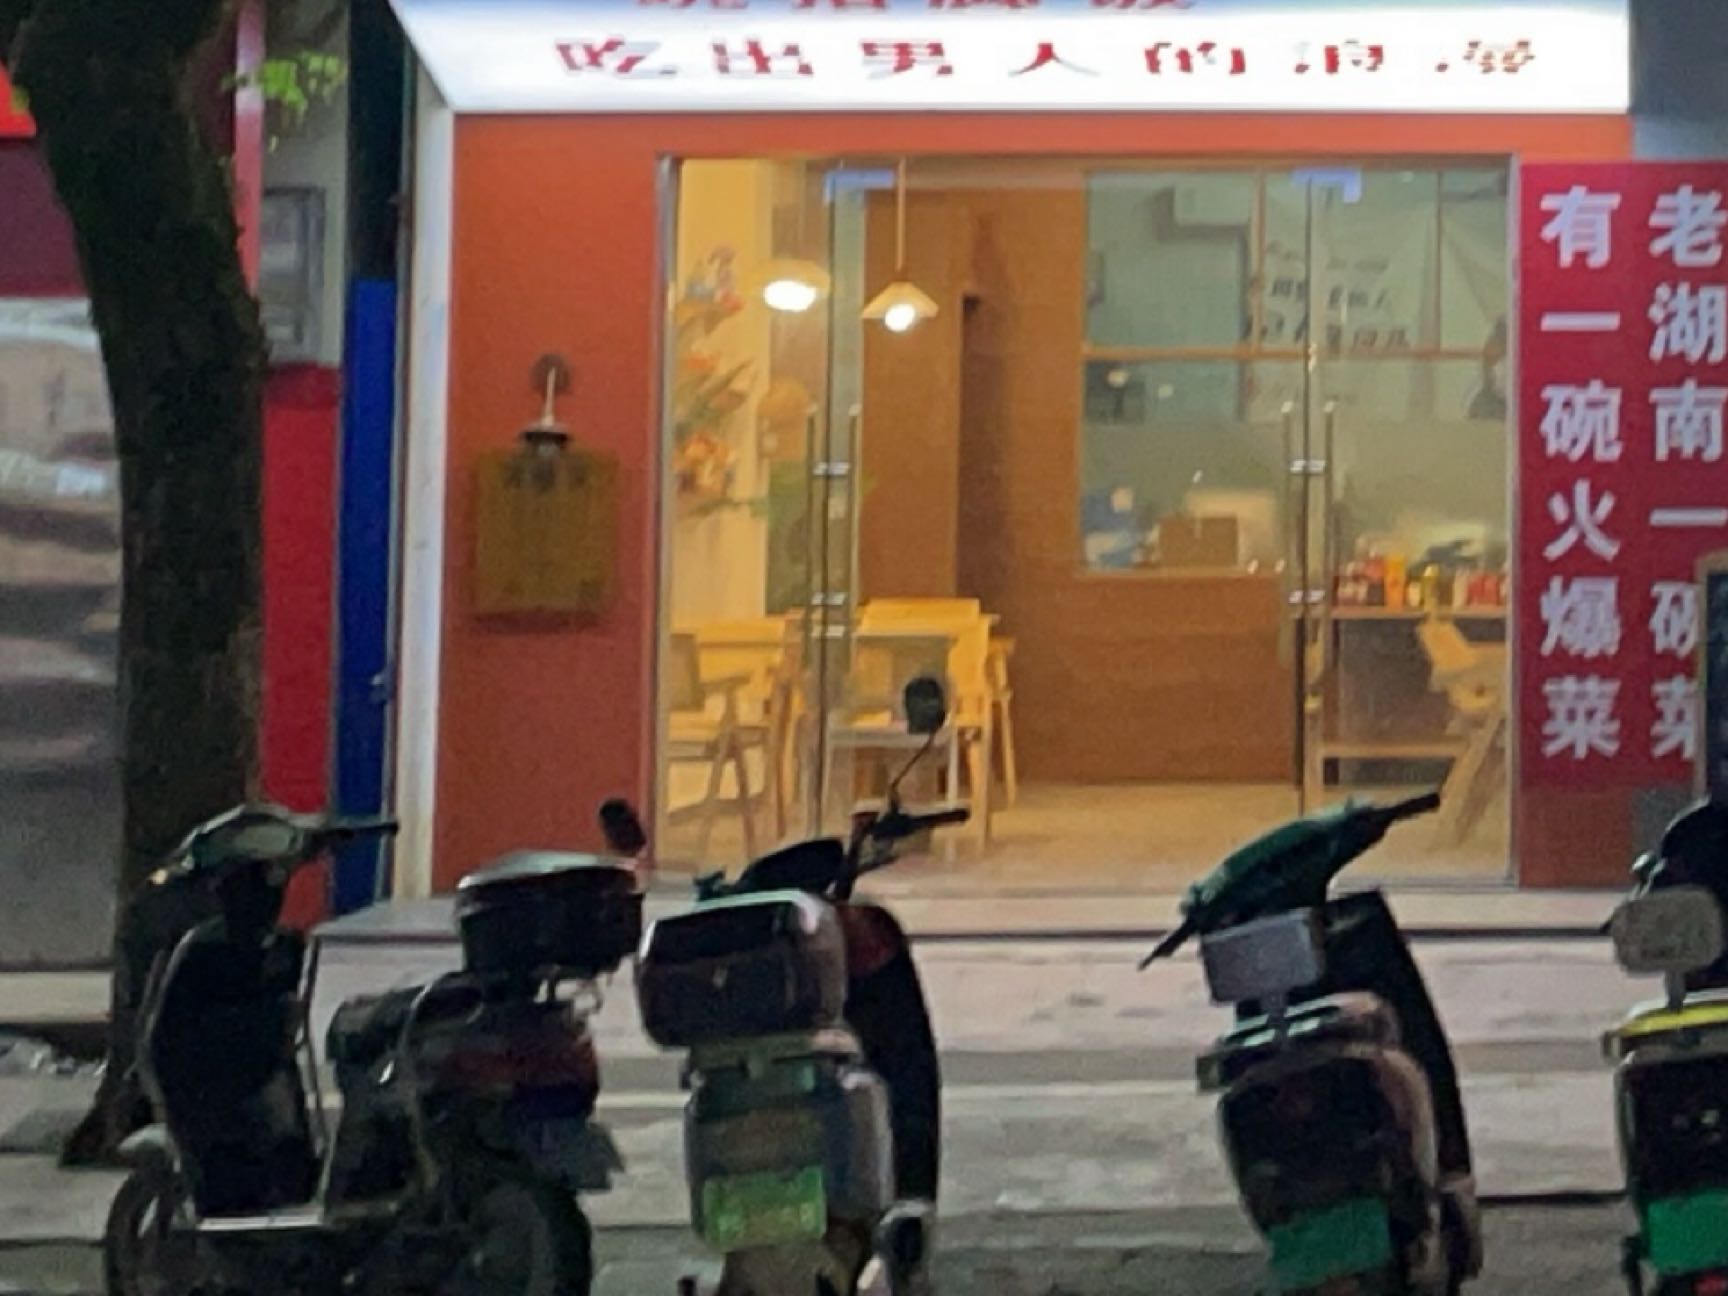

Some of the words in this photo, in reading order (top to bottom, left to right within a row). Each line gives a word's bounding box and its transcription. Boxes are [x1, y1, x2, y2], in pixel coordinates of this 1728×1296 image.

[1540, 185, 1622, 759] 有一碗火爆菜
